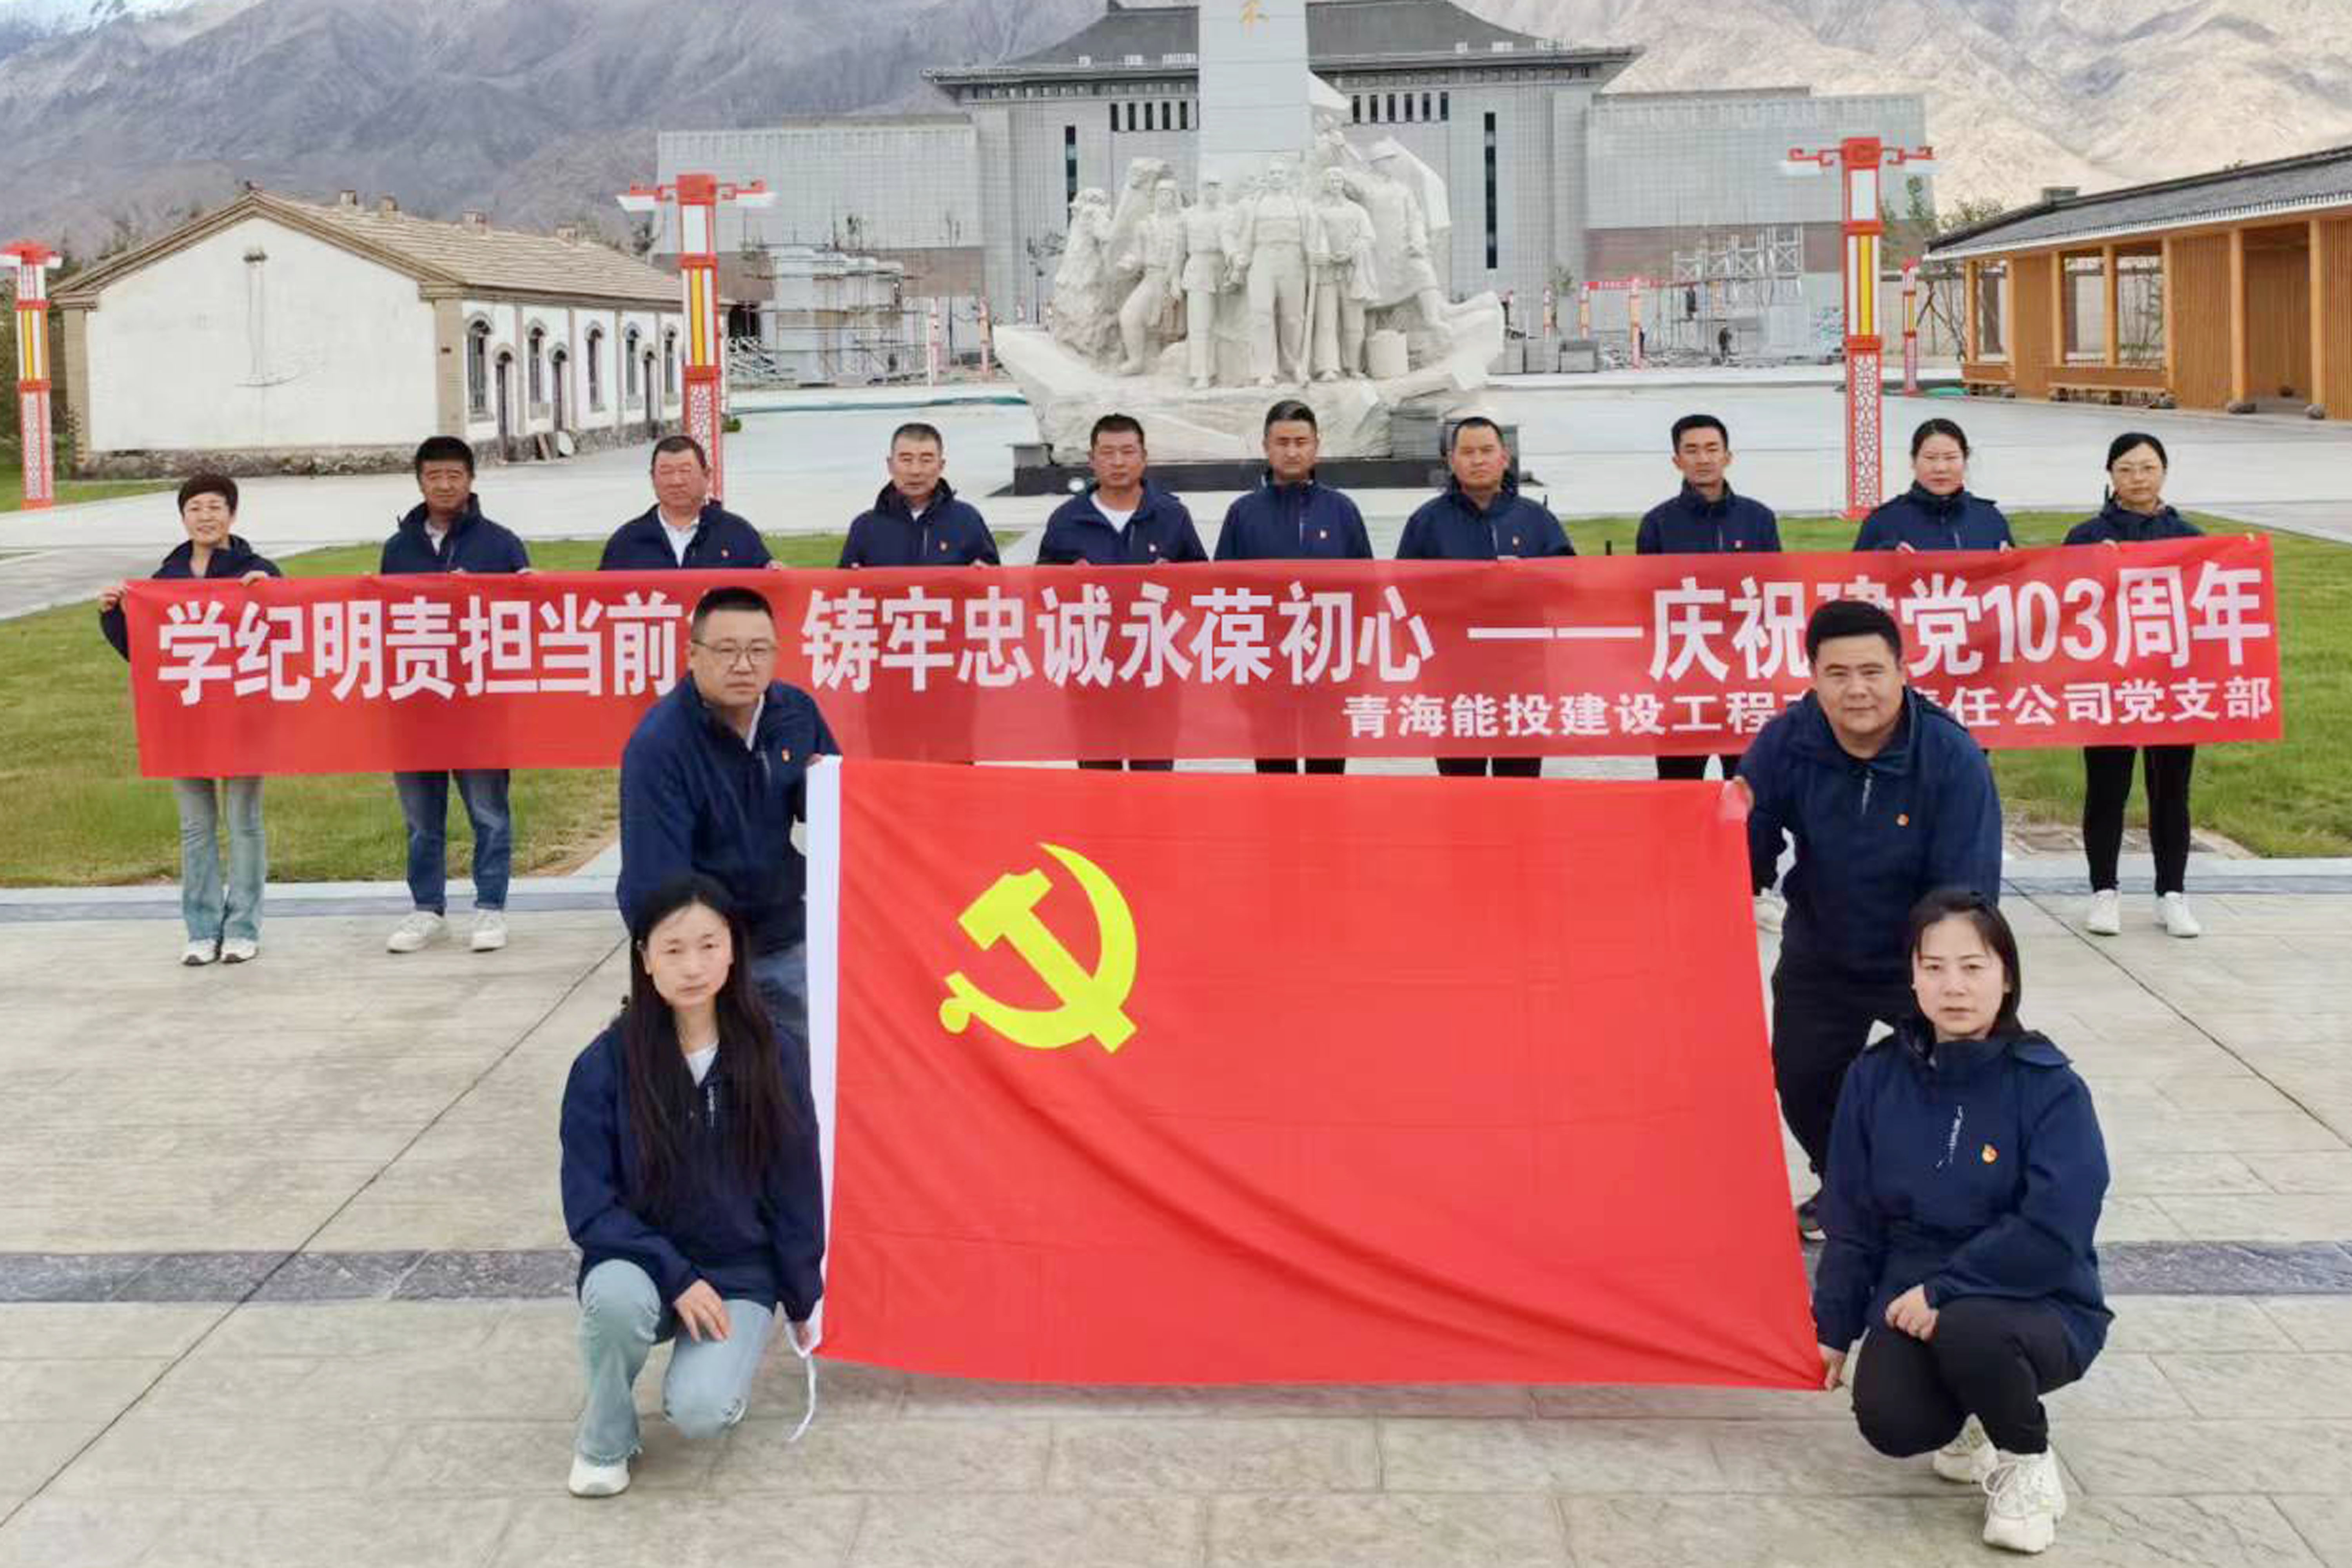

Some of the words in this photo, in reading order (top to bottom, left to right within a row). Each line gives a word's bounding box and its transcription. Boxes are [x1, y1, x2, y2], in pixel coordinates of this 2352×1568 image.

[158, 590, 708, 706] 学纪明责担当前
[801, 581, 1434, 693] 铸牢忠诚永葆初心
[1343, 676, 2273, 739] 青海能投建设工程任公司党支部
